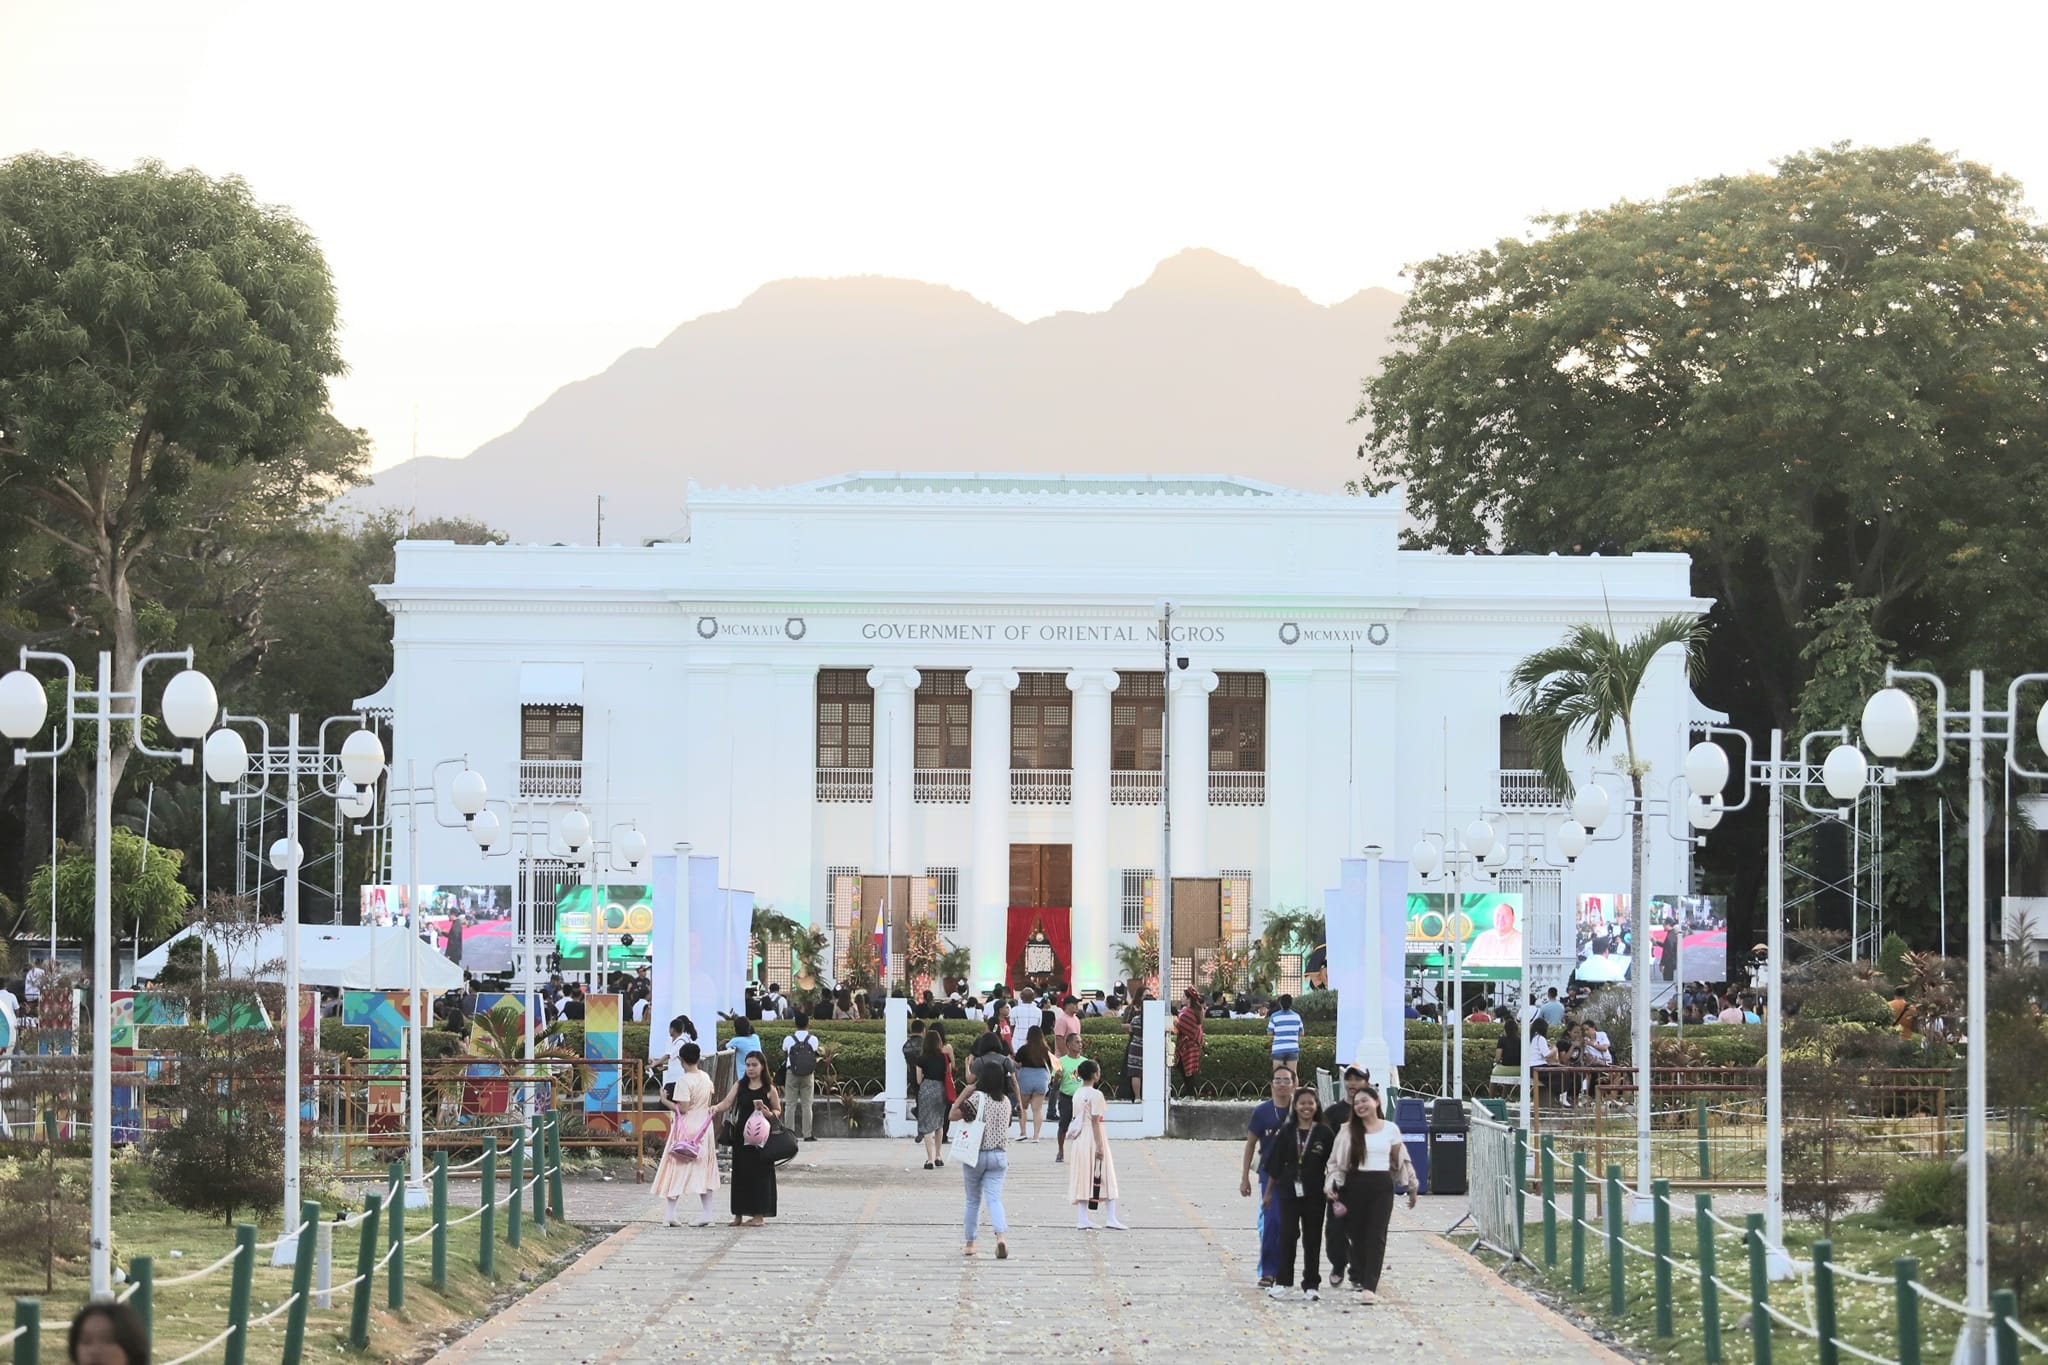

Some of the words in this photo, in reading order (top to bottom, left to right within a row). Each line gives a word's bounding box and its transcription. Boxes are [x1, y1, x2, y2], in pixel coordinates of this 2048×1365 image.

[721, 624, 783, 636] MCMXXIV
[861, 623, 996, 640] GOVERNMENT
[1004, 625, 1032, 640] OF
[1039, 625, 1139, 641] ORIENTAL
[1146, 626, 1225, 642] NGROS
[1303, 629, 1364, 641] MCMXXIV
[1411, 911, 1474, 941] 100
